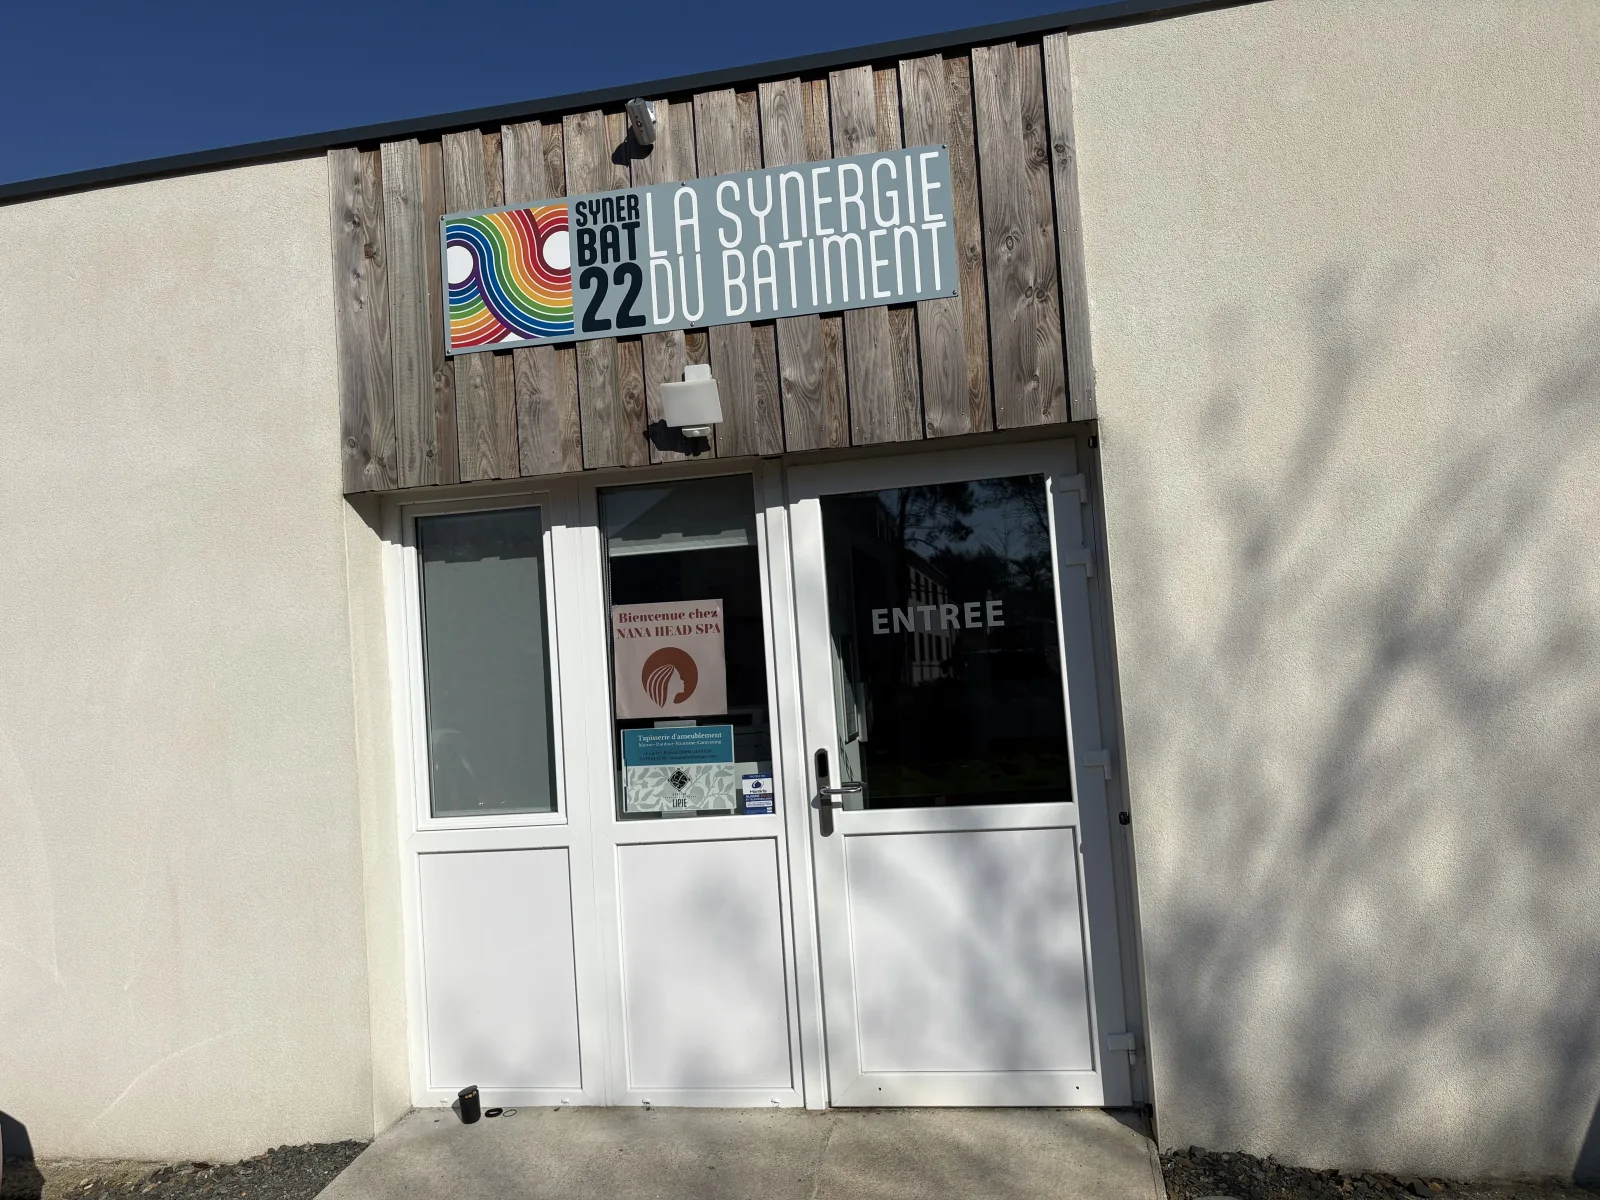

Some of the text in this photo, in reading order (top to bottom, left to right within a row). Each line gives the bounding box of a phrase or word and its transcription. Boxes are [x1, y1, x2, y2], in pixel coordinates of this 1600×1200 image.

[575, 193, 640, 227] SYNER
[646, 151, 944, 258] LA SYNERGIE
[576, 221, 641, 267] BAT
[650, 221, 947, 325] DU BATIMENT
[579, 262, 646, 333] 22
[617, 623, 721, 639] NANA HEAD SPA
[618, 608, 718, 623] Bienvenue chez
[871, 600, 1005, 634] ENTREE
[637, 733, 670, 742] Tapisserie
[672, 798, 687, 808] LIPIE
